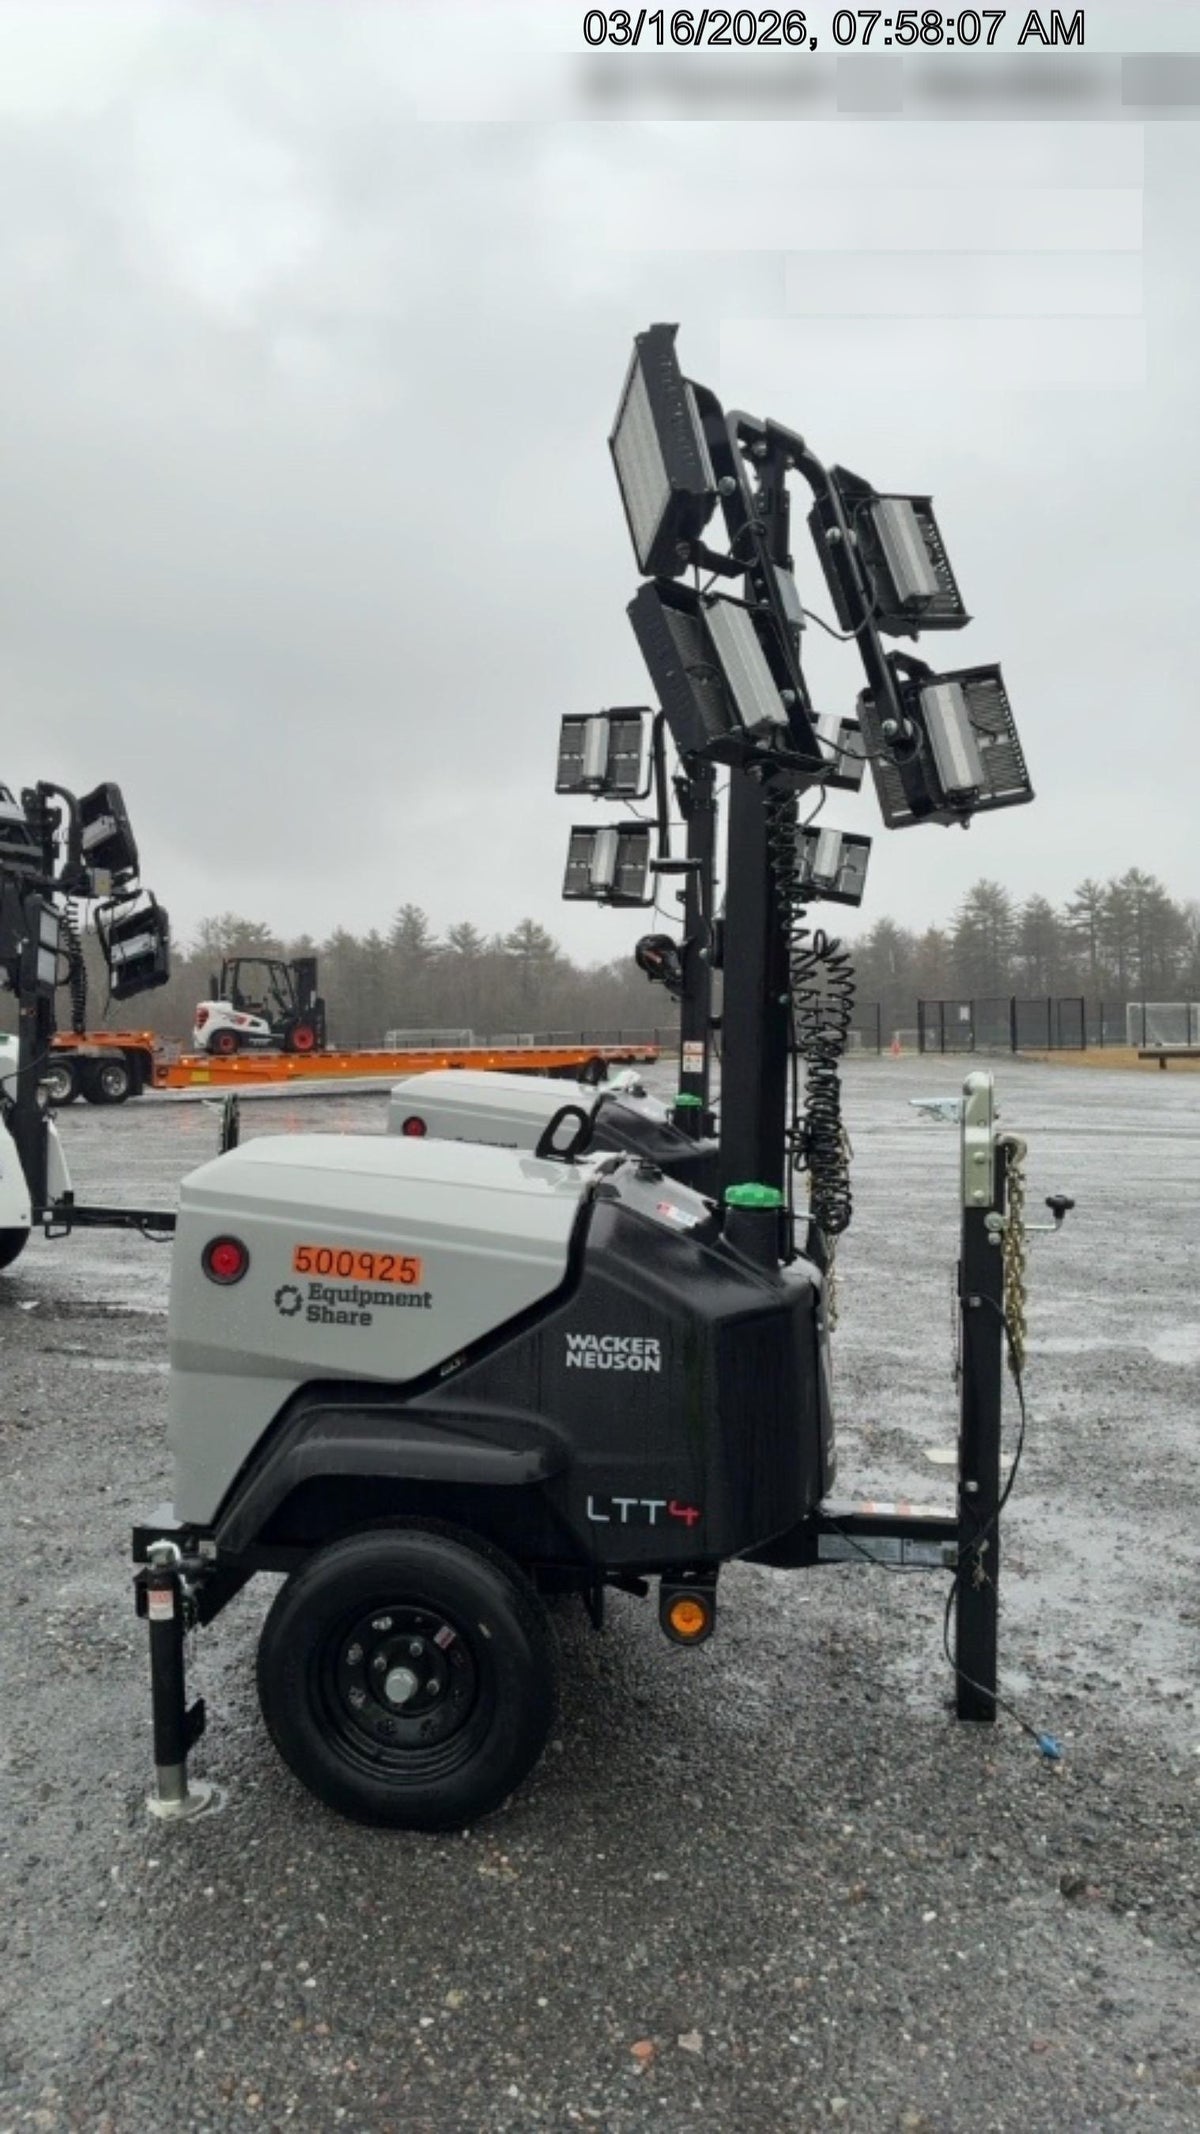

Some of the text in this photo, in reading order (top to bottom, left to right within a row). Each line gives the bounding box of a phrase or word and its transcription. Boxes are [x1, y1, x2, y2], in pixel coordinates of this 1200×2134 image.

[296, 1247, 416, 1284] 500925
[308, 1283, 432, 1309] Equipment
[306, 1305, 372, 1326] Share
[566, 1333, 660, 1354] WACKER
[566, 1351, 660, 1372] NEUSON
[587, 1495, 699, 1526] LTT4
